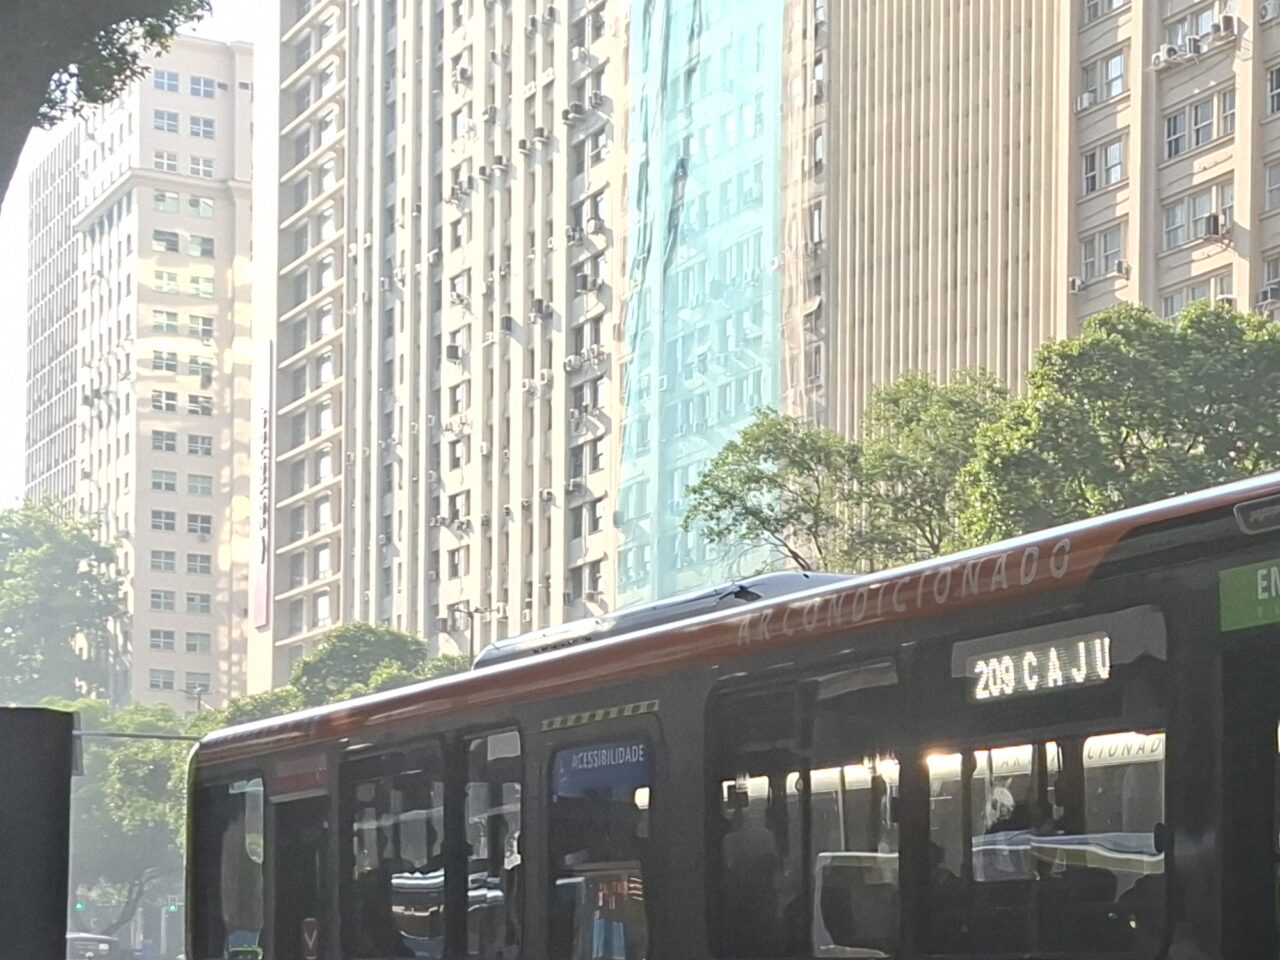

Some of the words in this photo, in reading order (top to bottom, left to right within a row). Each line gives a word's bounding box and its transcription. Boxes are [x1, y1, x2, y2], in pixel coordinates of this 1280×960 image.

[782, 538, 1072, 636] CONDICIONADO
[974, 655, 1014, 700] 209
[1023, 637, 1111, 691] CAJU
[572, 745, 645, 769] ACESSIBILIDADE
